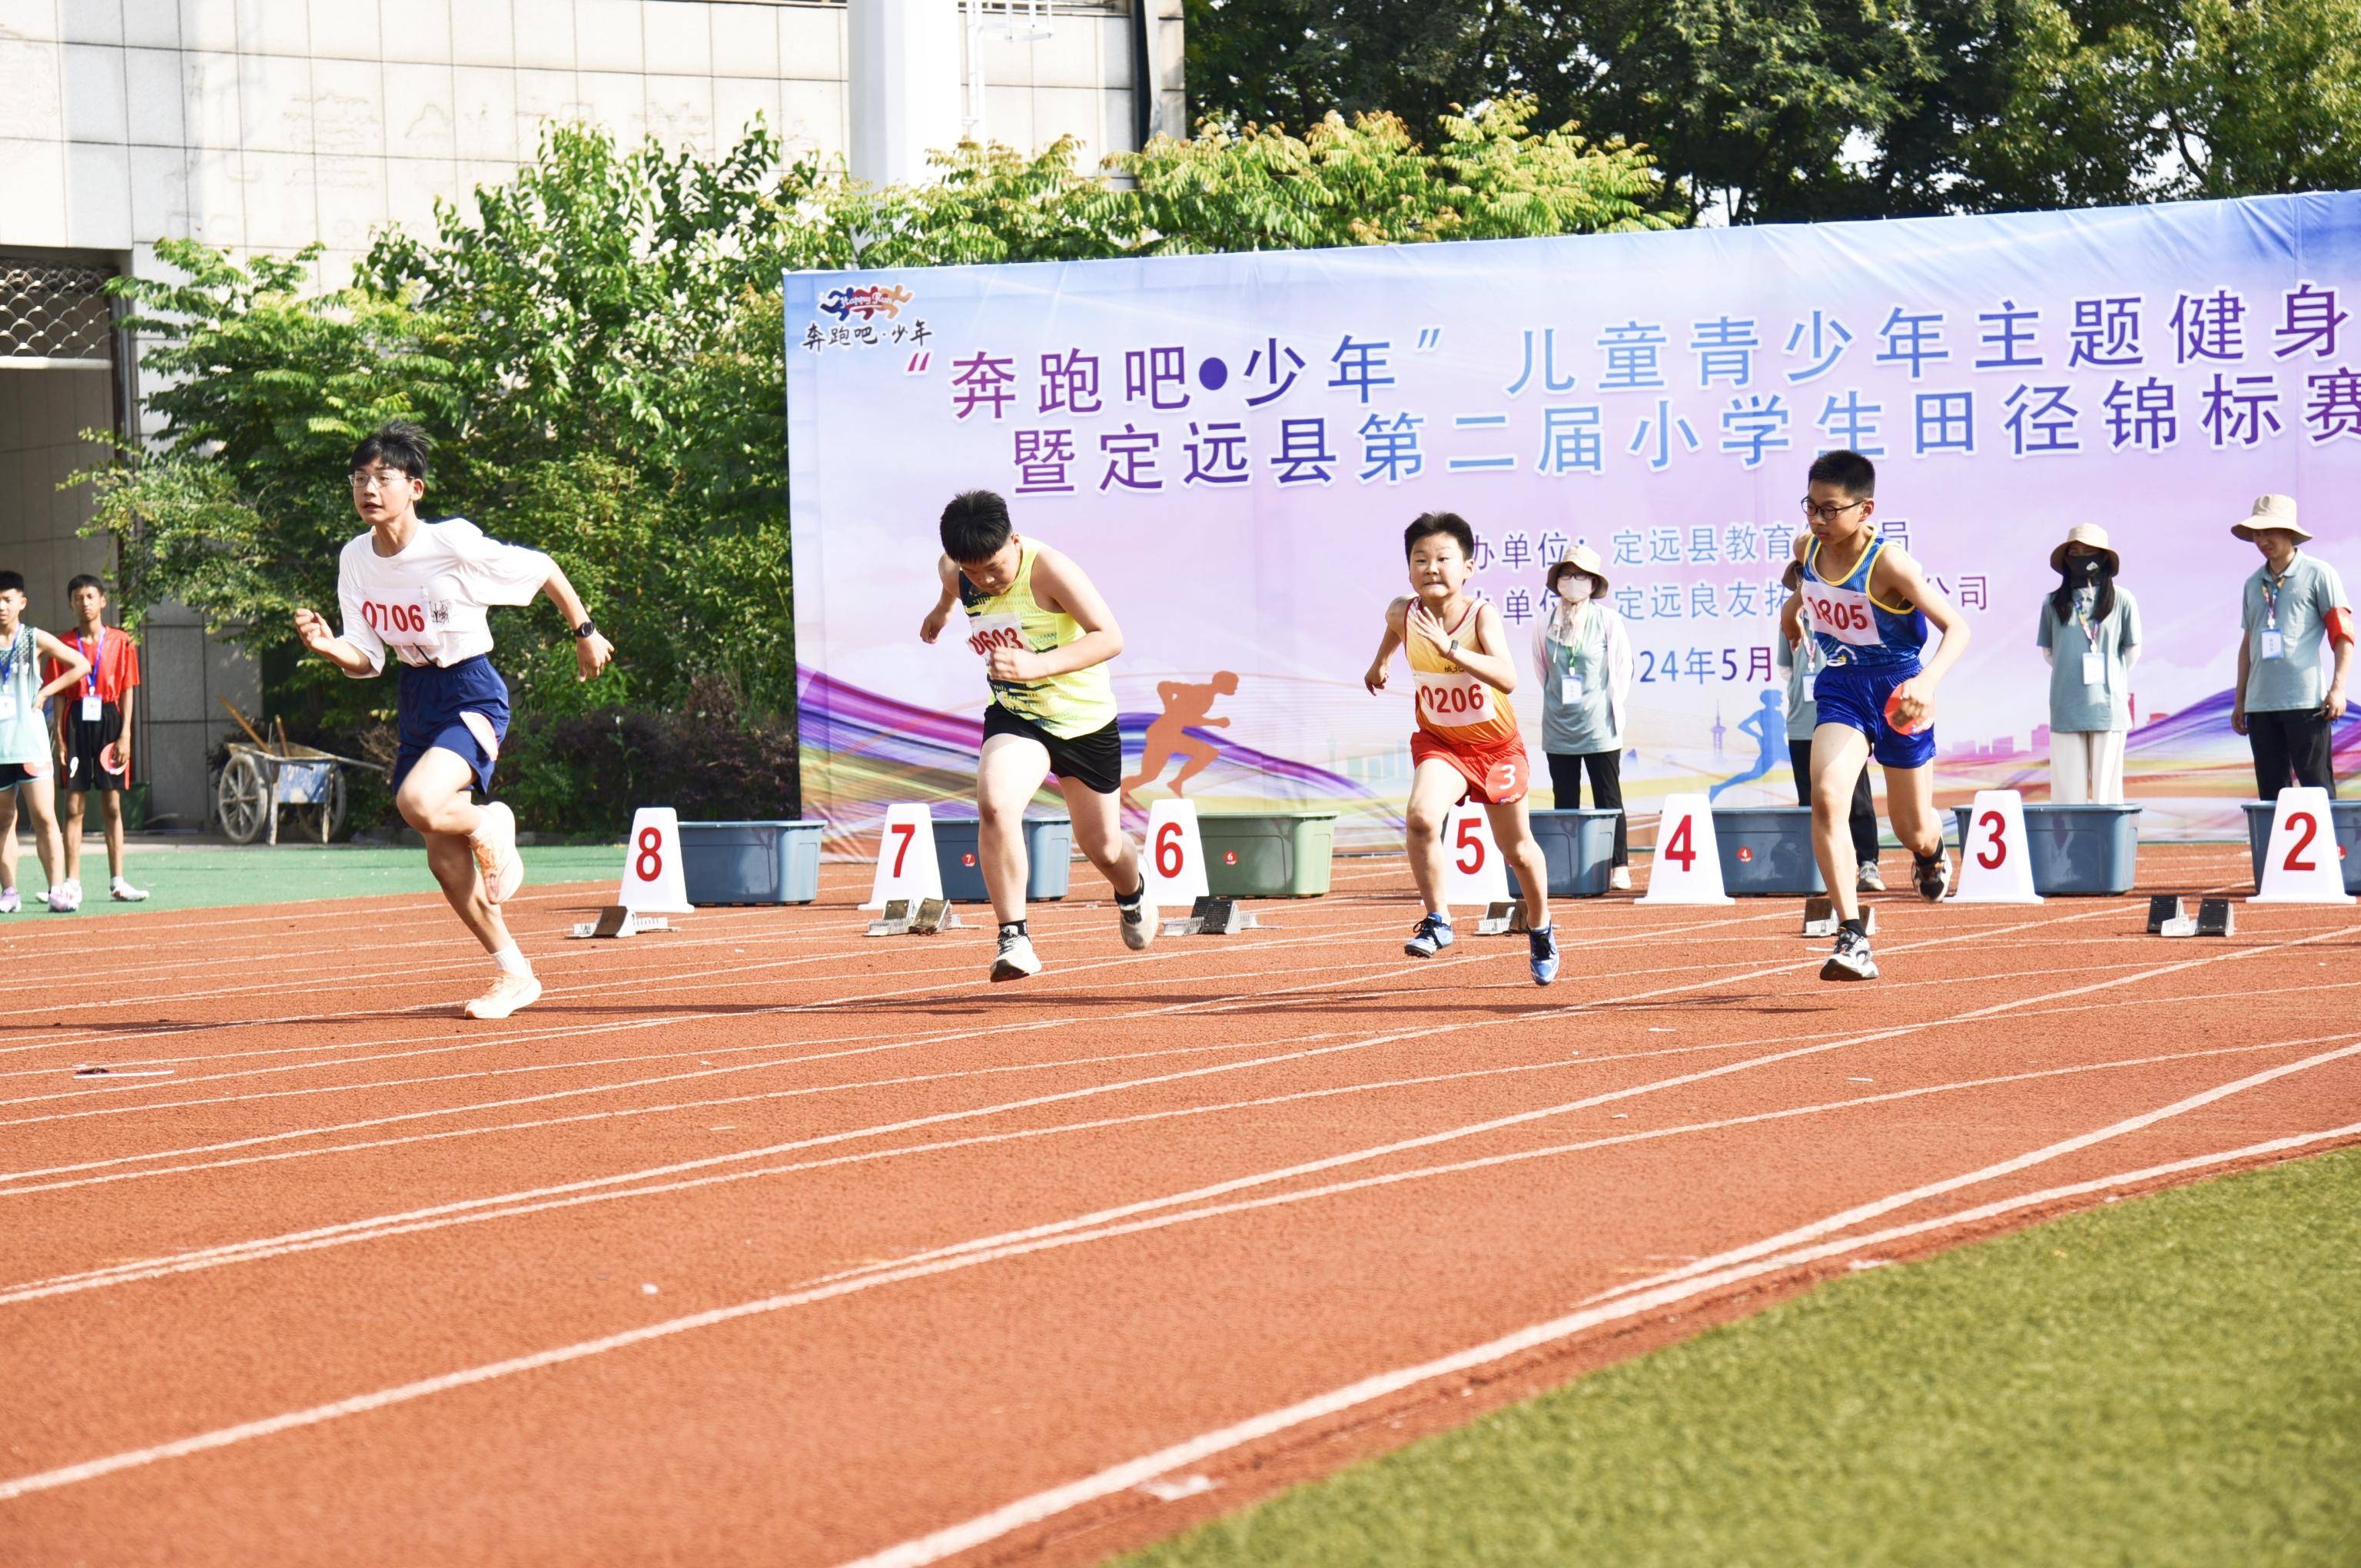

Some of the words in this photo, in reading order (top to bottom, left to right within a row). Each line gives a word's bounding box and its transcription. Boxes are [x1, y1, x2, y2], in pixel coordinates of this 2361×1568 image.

[1013, 367, 2361, 493] 暨定远县第二届小学生田径锦标赛
[362, 600, 425, 632] 0706
[1629, 646, 1772, 685] 24年5月
[1420, 683, 1484, 713] 0206
[1499, 764, 1516, 789] 3
[636, 827, 662, 882] 8
[892, 824, 915, 879] 7
[1155, 822, 1184, 879] 6
[1456, 818, 1485, 875] 5
[1665, 815, 1696, 872] 4
[1977, 811, 2007, 869] 3
[2283, 812, 2317, 871] 2
